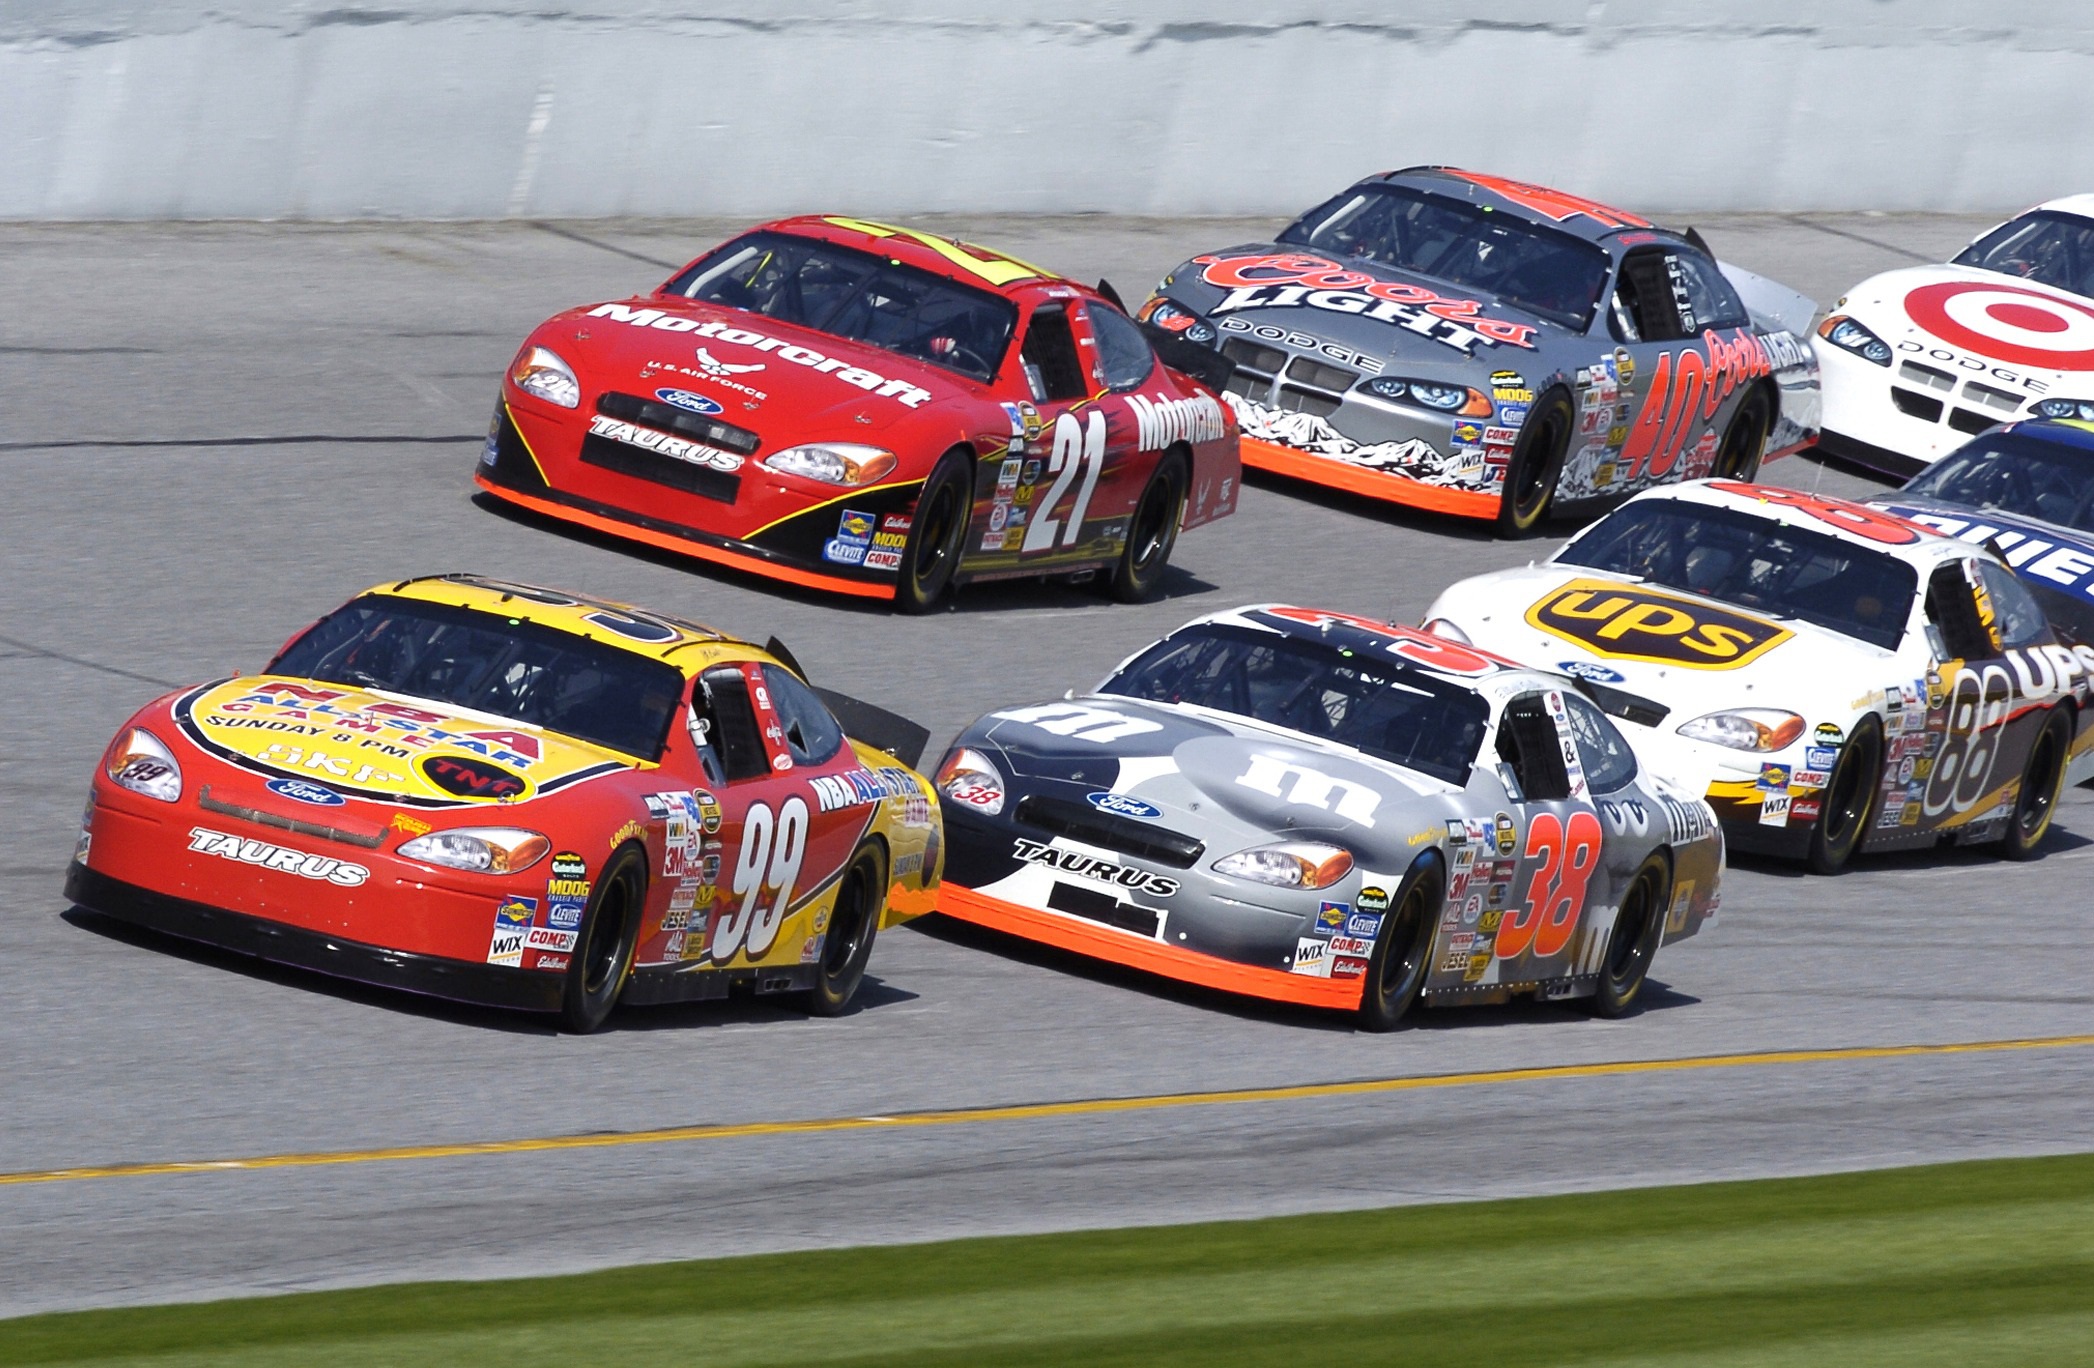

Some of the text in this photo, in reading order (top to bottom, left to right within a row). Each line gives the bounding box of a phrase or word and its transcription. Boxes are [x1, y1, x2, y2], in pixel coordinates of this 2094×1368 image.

[1192, 254, 1538, 349] Coors
[1208, 286, 1495, 354] LIGHT
[586, 303, 934, 409] Motorcraft
[1219, 316, 1386, 375] DODGE
[647, 360, 768, 402] U.S. AIR FORCE
[1897, 341, 2050, 394] DODGE
[667, 391, 709, 411] Ford
[1493, 388, 1534, 402] MOOG
[1619, 348, 1706, 481] 40
[589, 414, 746, 472] TAURUS
[1486, 429, 1514, 441] COMP
[1461, 453, 1483, 468] WIX
[1022, 411, 1106, 553] 21
[867, 552, 898, 566] COMP
[1567, 663, 1616, 682] Ford
[2004, 644, 2094, 700] UPS
[205, 714, 409, 760] SUNDAY 8 PM
[221, 703, 433, 750] GAME
[249, 682, 545, 760] NBA
[991, 702, 1165, 744] m
[1923, 664, 2013, 817] 88
[124, 763, 167, 781] 99
[257, 743, 407, 786] SKF
[1794, 771, 1822, 783] COMP
[285, 780, 334, 804] Ford
[809, 774, 858, 812] NBA
[955, 786, 1001, 805] 38
[1100, 795, 1149, 816] Ford
[1235, 753, 1382, 829] m
[1764, 797, 1790, 814] WIX
[189, 827, 370, 887] TAURUS
[664, 847, 683, 876] 3M
[1012, 838, 1182, 897] TAURUS
[548, 880, 591, 897] MOOG
[712, 798, 810, 960] 99
[1449, 873, 1471, 900] 3M
[1495, 811, 1603, 960] 38
[493, 935, 523, 955] WIX
[529, 930, 568, 946] COMP
[1298, 943, 1325, 961] WIX
[1331, 938, 1363, 951] COMP
